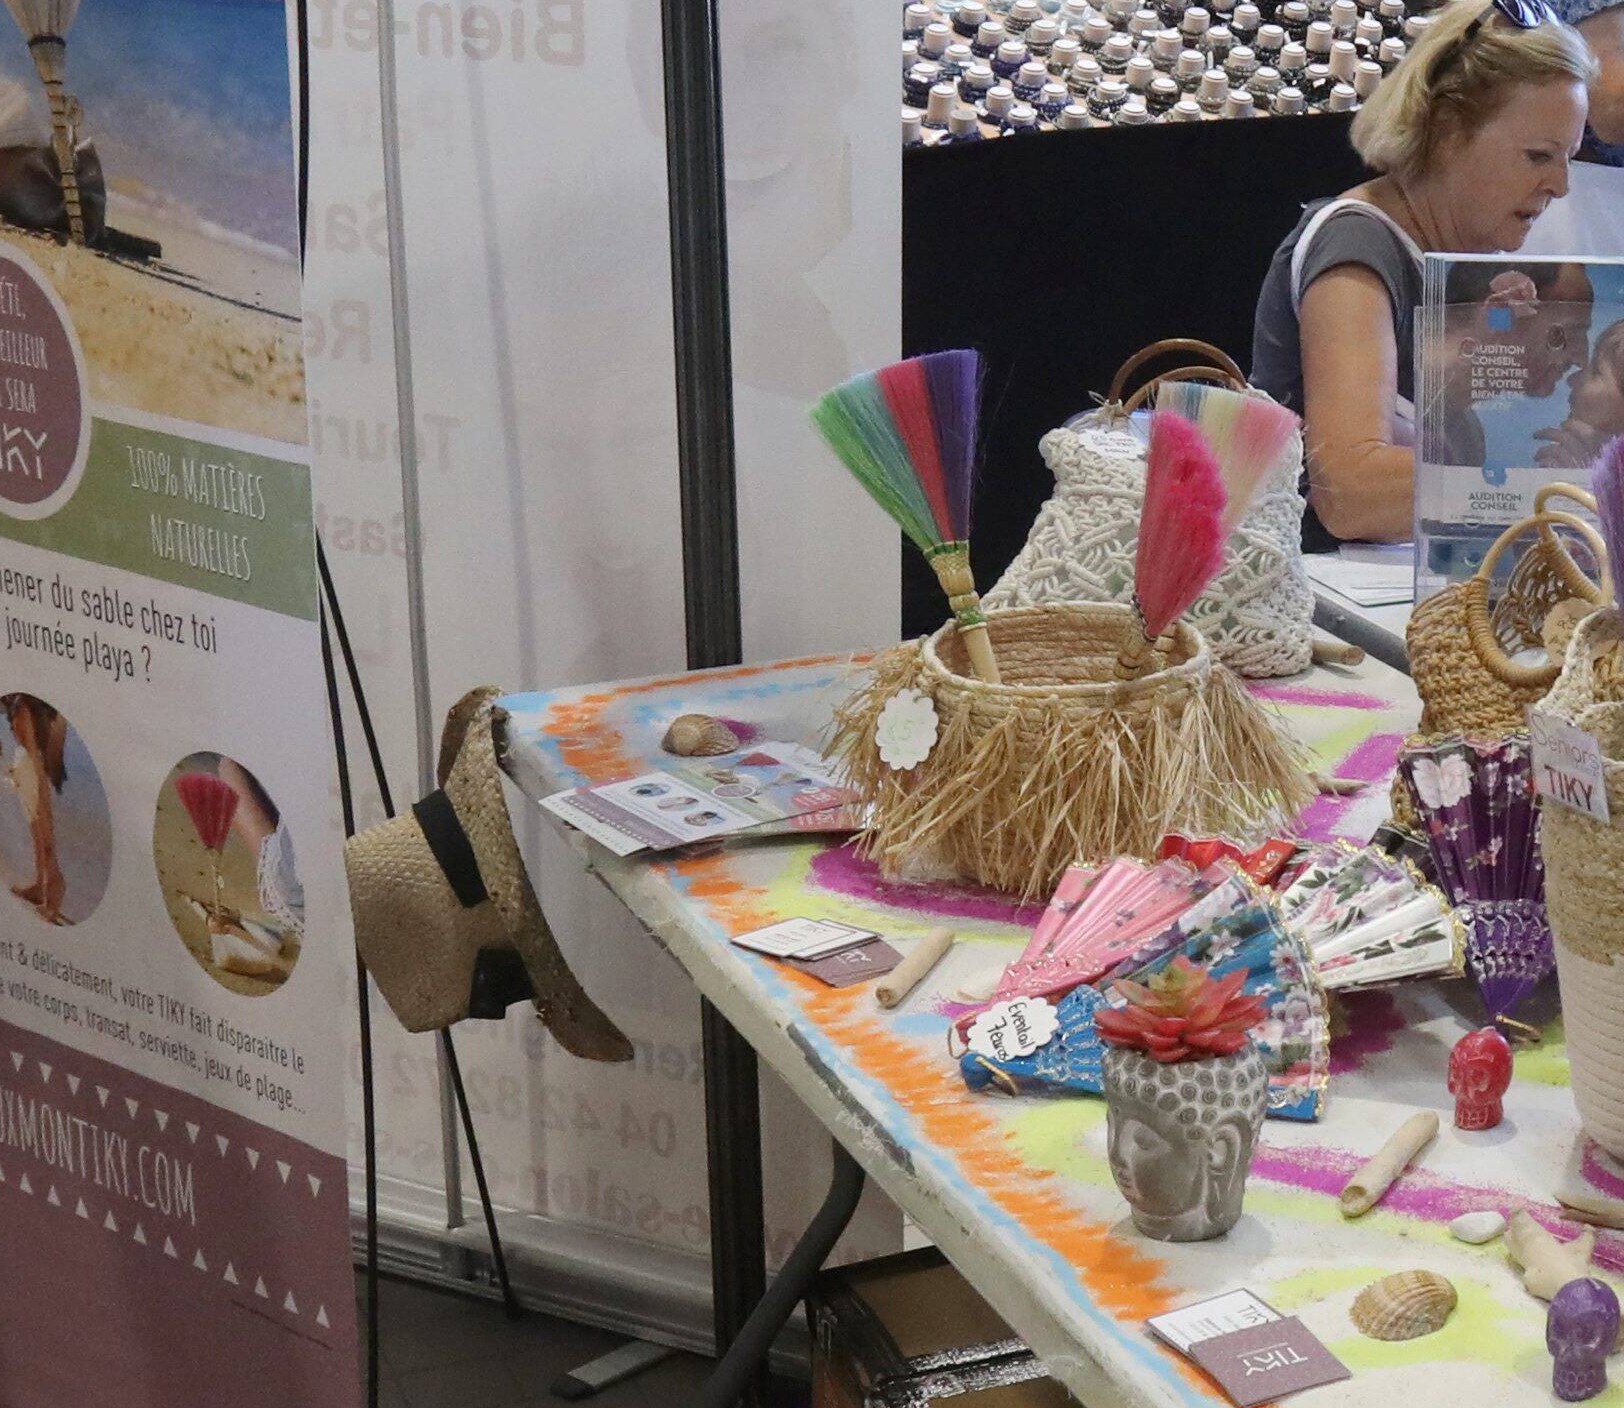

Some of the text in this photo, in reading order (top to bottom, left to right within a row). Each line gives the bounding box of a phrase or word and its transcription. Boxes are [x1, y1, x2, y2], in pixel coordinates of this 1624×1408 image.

[4, 376, 38, 415] SERA
[1471, 367, 1529, 378] LE CENTRE
[1471, 379, 1525, 389] DE VOTRE
[125, 443, 267, 523] 100% MATIÈRES
[1468, 491, 1523, 502] AUDITION
[1470, 501, 1518, 512] CONSEIL
[149, 512, 253, 582] NATURELLES
[50, 573, 75, 613] du
[81, 582, 134, 632] sable
[140, 596, 184, 645] chez
[189, 607, 218, 654] toi
[5, 605, 76, 661] journée
[82, 634, 135, 680] playa
[140, 645, 153, 683] ?
[1544, 763, 1593, 812] TIKY
[17, 942, 27, 966] &
[32, 946, 118, 1003] délicatement,
[120, 984, 154, 1015] votre
[158, 994, 186, 1026] TIKY
[189, 1006, 213, 1039] fait
[291, 1048, 306, 1075] le
[85, 1007, 252, 1091] transat, serviette, jeux de
[1242, 1346, 1310, 1377] TIKY
